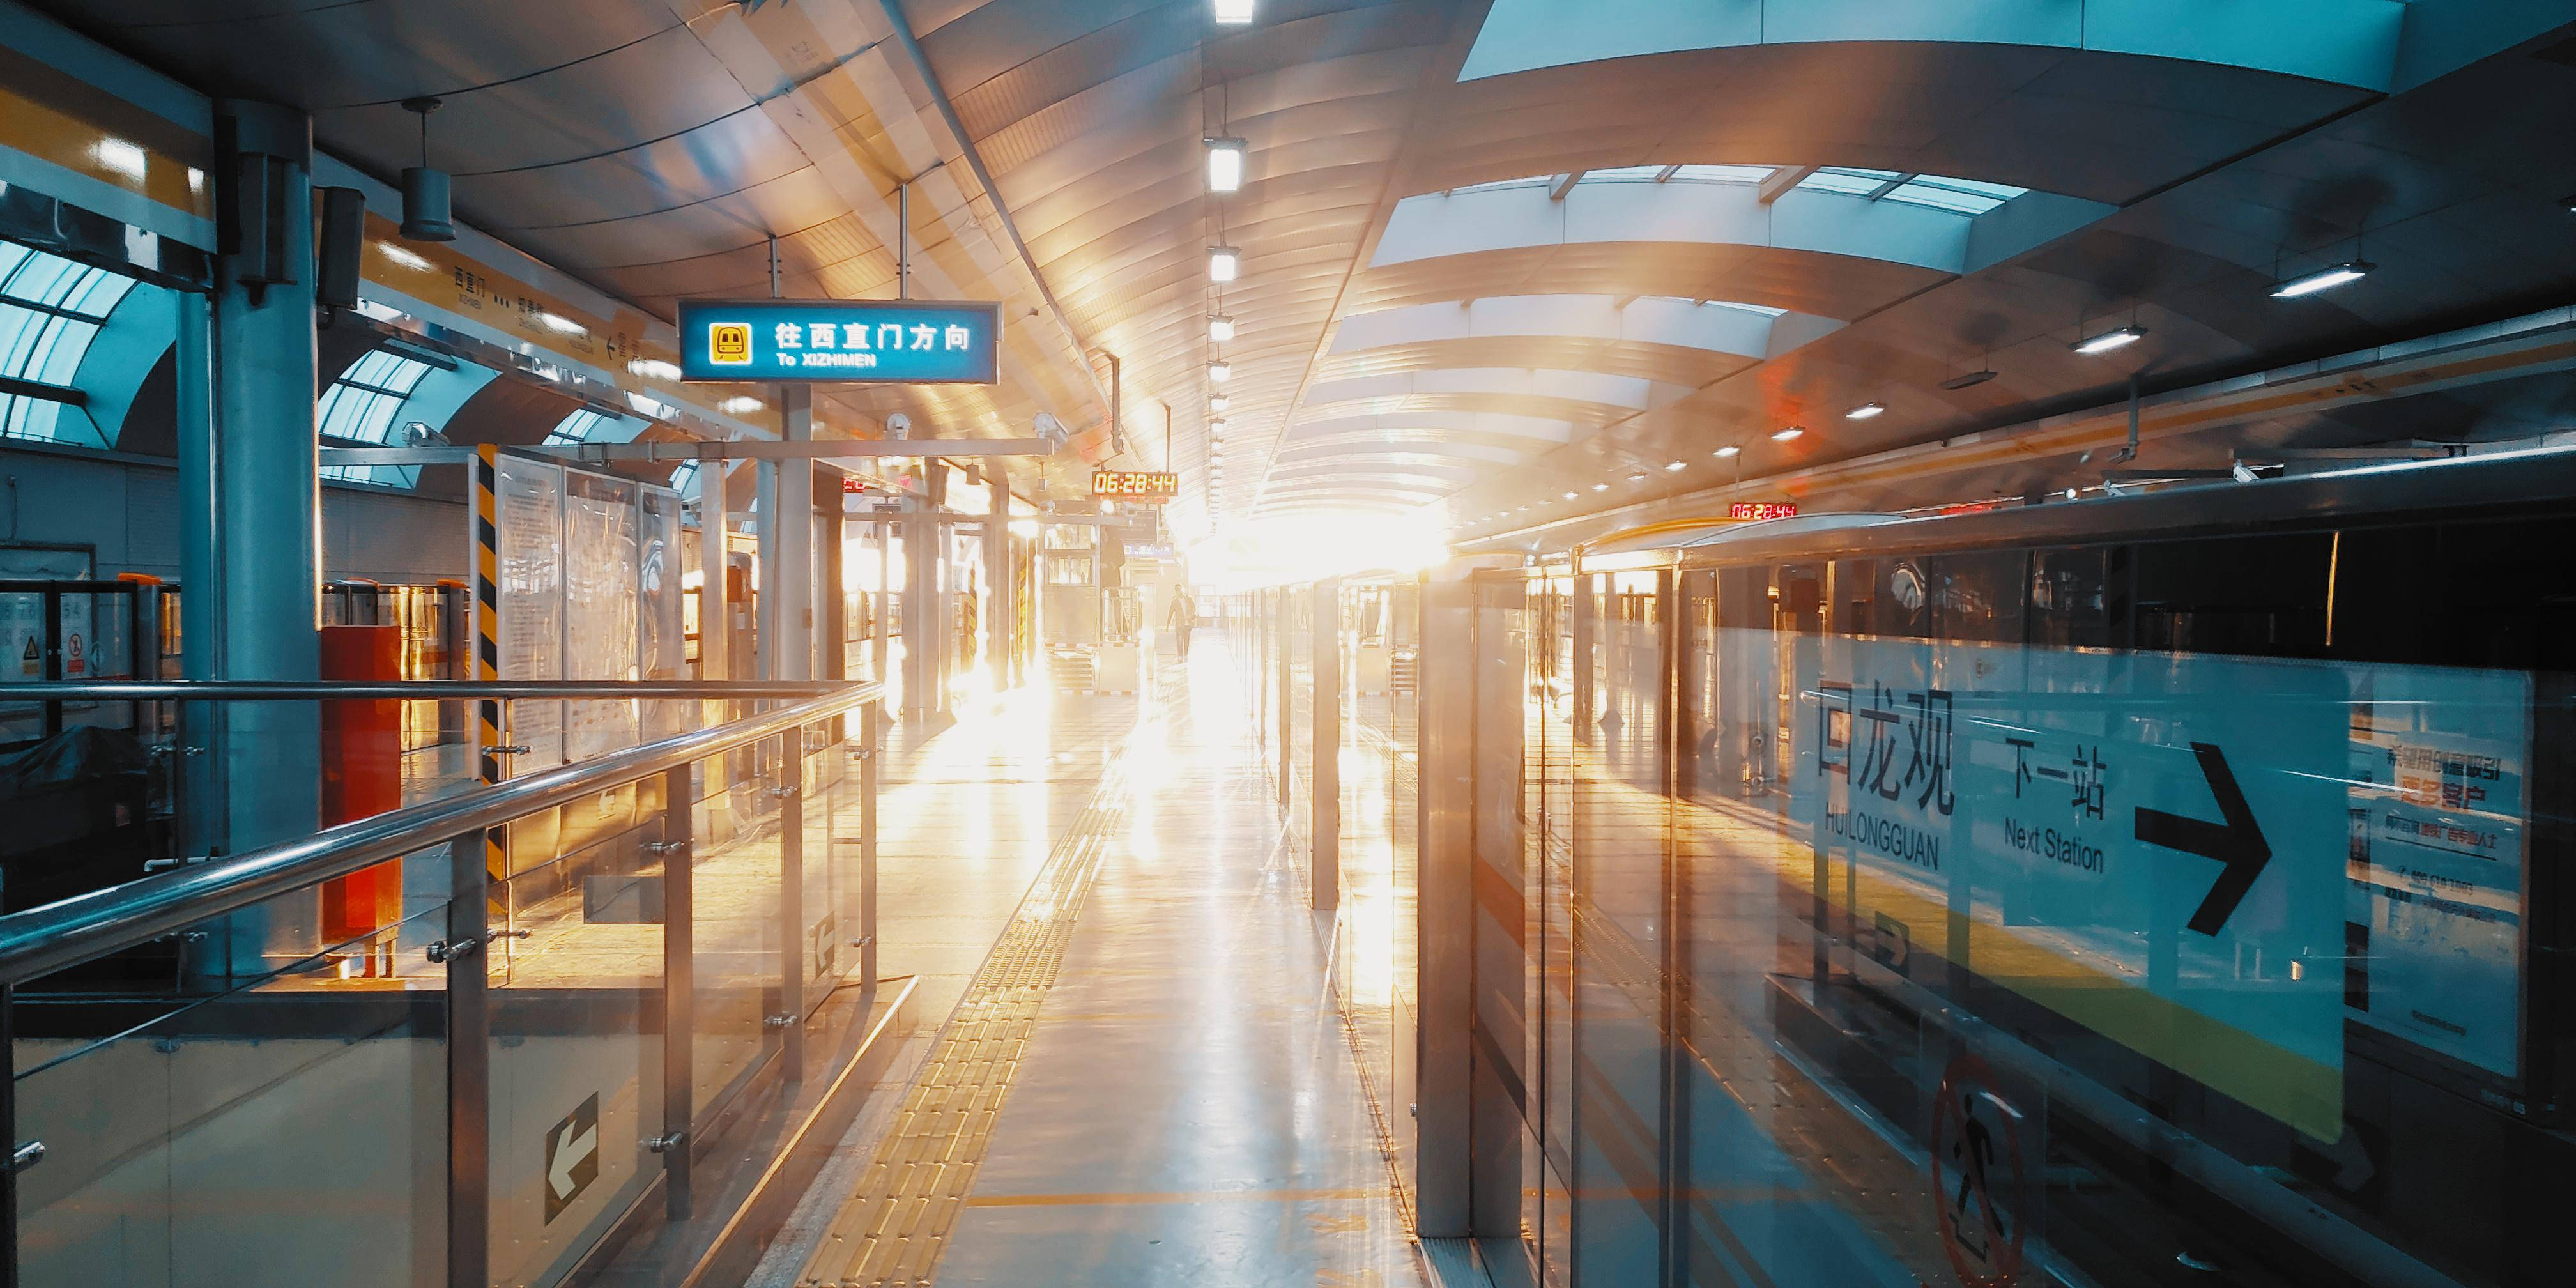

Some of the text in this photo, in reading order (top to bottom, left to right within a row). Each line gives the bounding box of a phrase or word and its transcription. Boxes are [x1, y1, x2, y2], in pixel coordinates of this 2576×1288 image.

[774, 322, 969, 350] 往西直门方向
[776, 353, 876, 367] To XIZHIMEN
[1094, 473, 1176, 494] 06:28:44
[1732, 504, 1795, 519] 06:28:44
[1818, 679, 1955, 816] 回龙观
[2005, 736, 2107, 820] 下一站
[1825, 804, 1940, 870] HUILONGGUAN
[2005, 818, 2104, 873] Next Station
